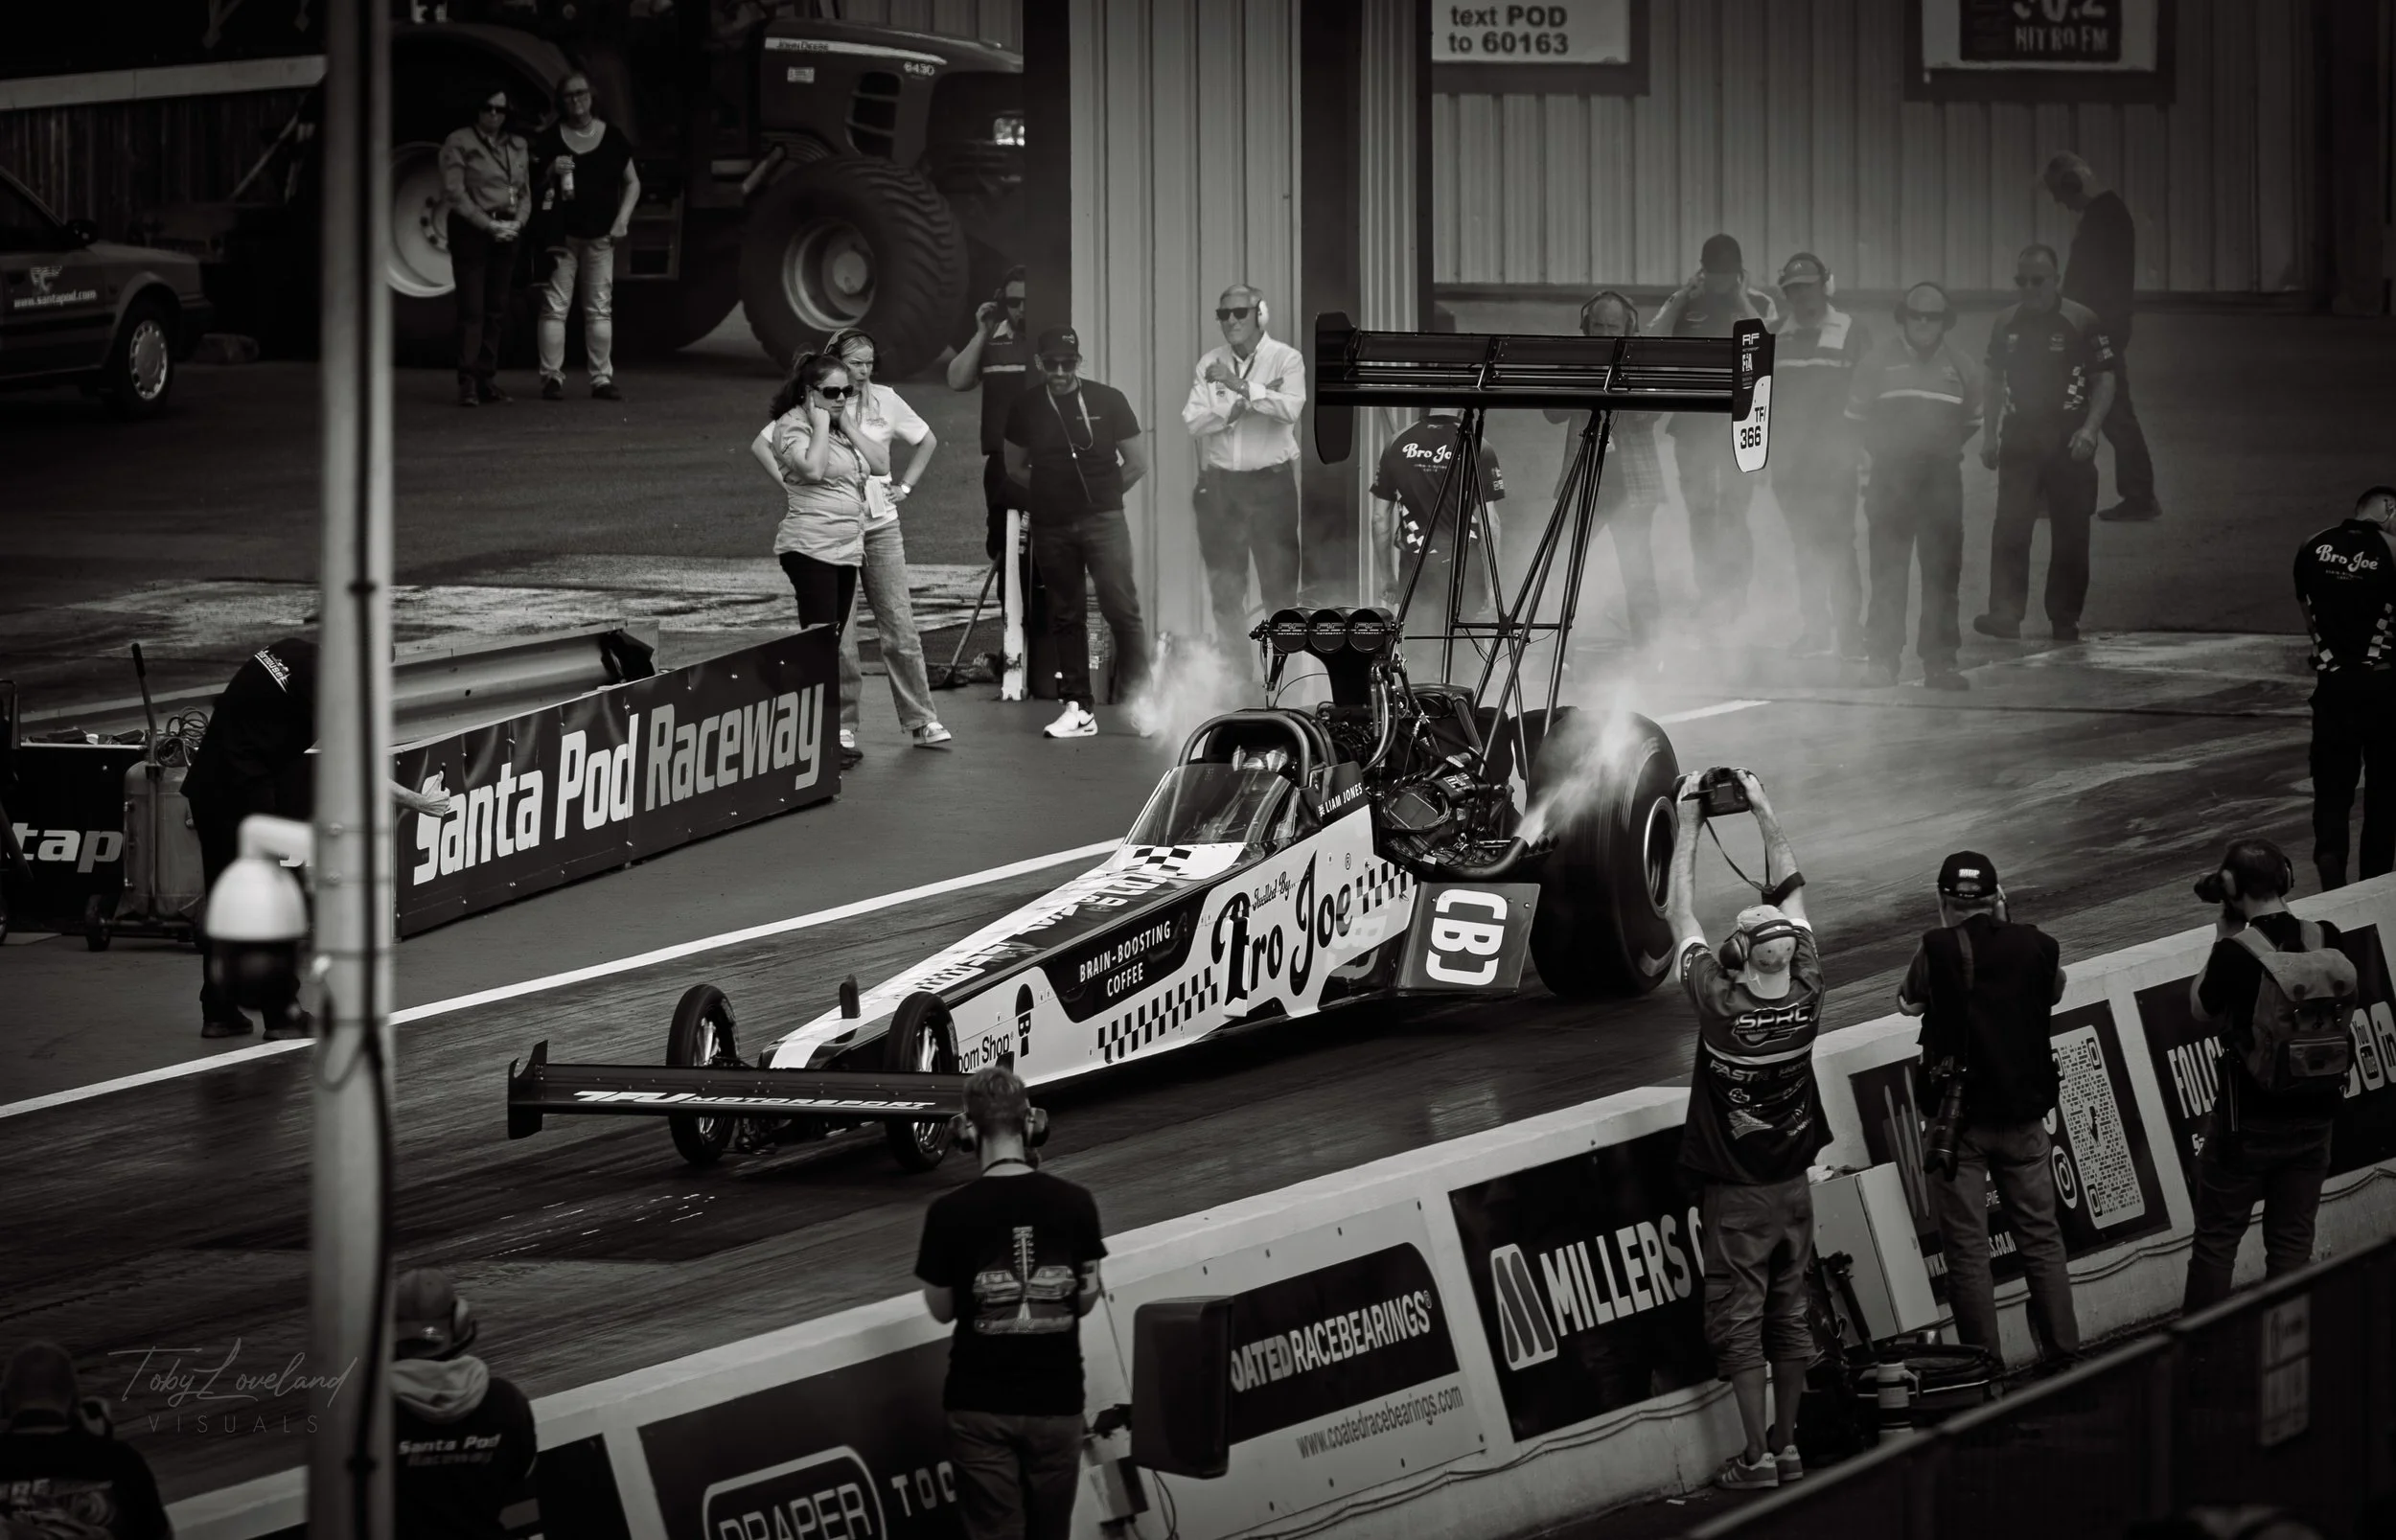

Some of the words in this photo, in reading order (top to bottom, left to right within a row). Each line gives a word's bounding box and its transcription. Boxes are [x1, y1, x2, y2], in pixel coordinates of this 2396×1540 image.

[1451, 6, 1498, 27] text
[1508, 5, 1568, 27] POD
[1448, 32, 1473, 53] to
[1482, 31, 1569, 55] 60163
[2016, 26, 2077, 52] NITRO
[2081, 25, 2108, 53] FM
[1402, 443, 1433, 459] Bro
[1433, 445, 1455, 463] Jo
[1740, 425, 1762, 449] 366
[2315, 544, 2348, 565] Bro
[2347, 550, 2379, 572] Joe
[413, 763, 544, 885] Santa
[555, 713, 639, 840] Pod
[645, 682, 825, 812] Raceway
[1325, 794, 1342, 814] LIAM
[1343, 782, 1363, 804] JONES
[12, 822, 124, 873] tap
[1290, 849, 1353, 997] Joe
[1079, 919, 1172, 983] BRAIN-BOOSTING
[1106, 961, 1144, 998] COFFEE
[958, 1046, 979, 1074] oom
[981, 1034, 1010, 1064] Shop
[2167, 1035, 2224, 1119] FOLLO
[687, 1095, 935, 1109] MOTORSPORT
[1539, 1213, 1693, 1338] MILLERS
[1295, 1385, 1464, 1459] www.coatedracebearings.com
[398, 1438, 457, 1456] Santa
[463, 1434, 502, 1450] Pod
[889, 1460, 958, 1518] TOO
